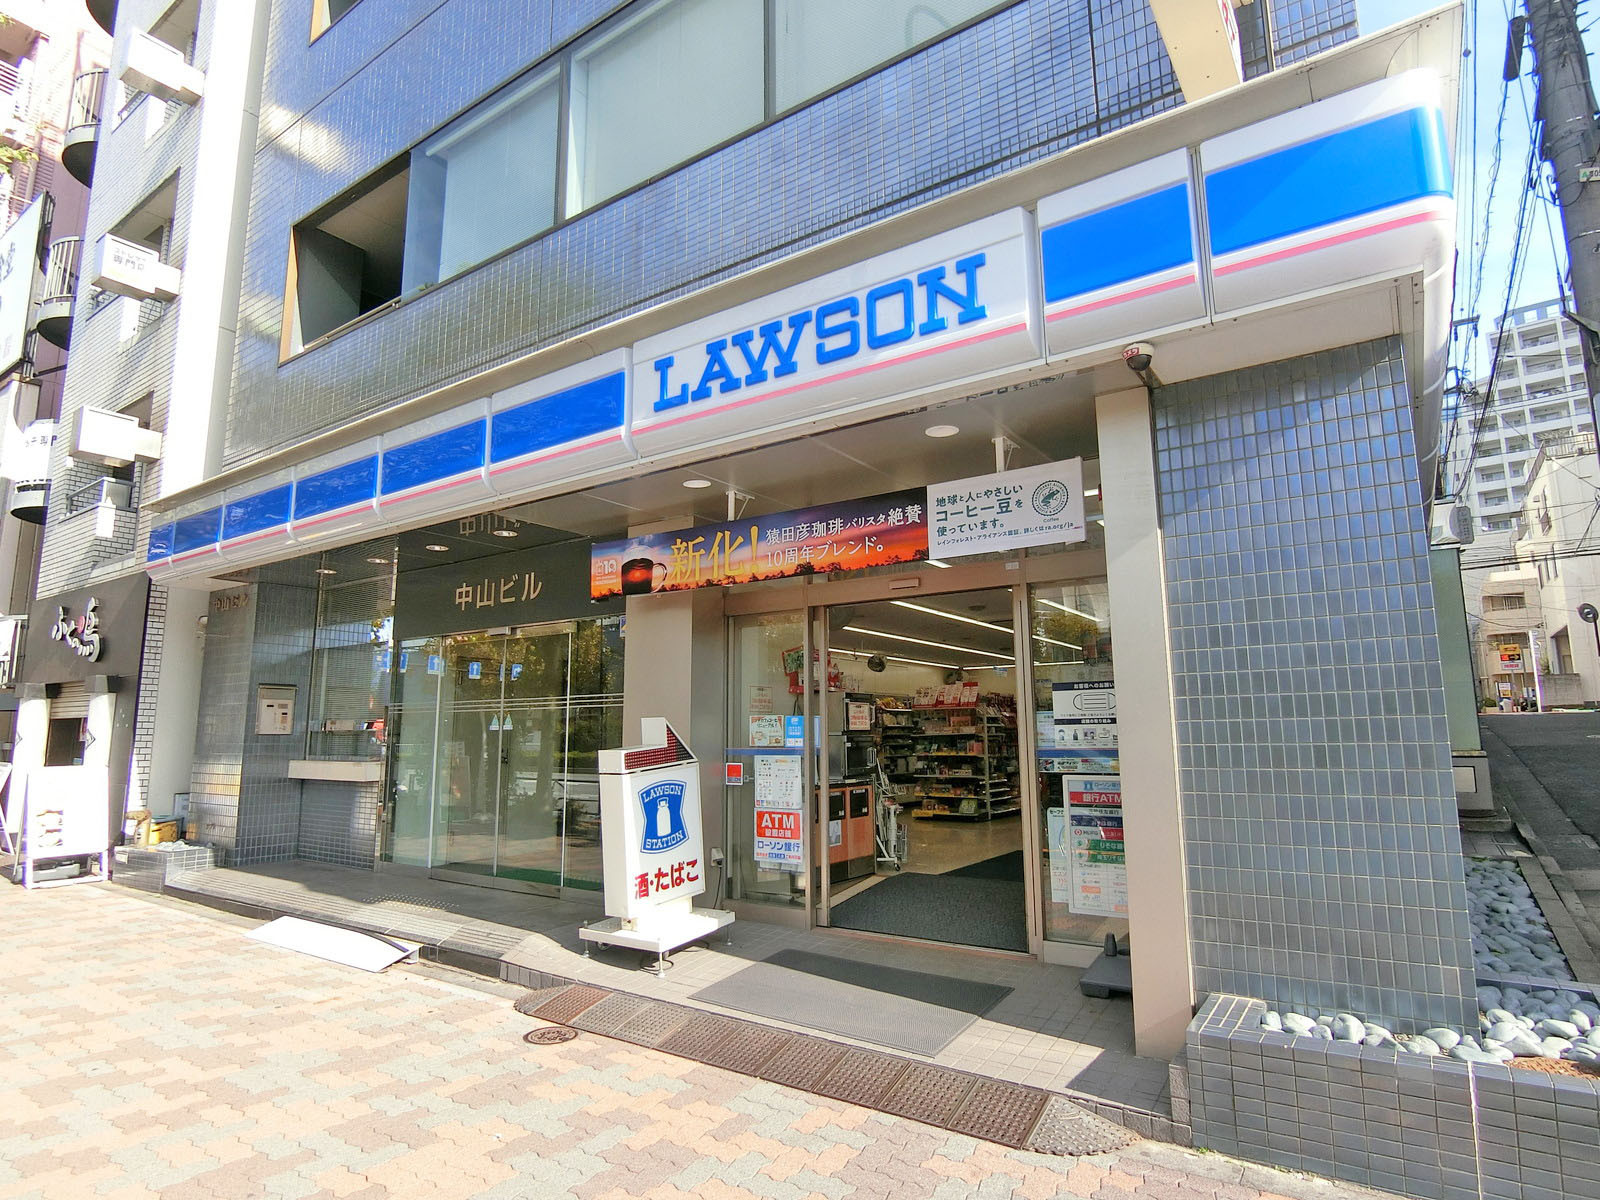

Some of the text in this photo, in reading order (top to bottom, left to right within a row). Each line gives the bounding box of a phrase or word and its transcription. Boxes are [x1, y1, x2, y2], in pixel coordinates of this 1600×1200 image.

[653, 252, 989, 412] LAWSON
[935, 484, 1043, 507] 地球と人にやさしい
[935, 497, 1023, 523] コーヒー豆を
[765, 503, 923, 546] 猿田彦珈琲バリスタ絶賛
[936, 518, 1005, 538] 使っています。
[767, 536, 884, 568] 10周年ブレンド。
[455, 572, 542, 611] 中山ビル
[643, 785, 682, 803] LAWSON
[761, 813, 794, 829] ATM
[645, 830, 684, 849] STATION
[757, 840, 801, 852] ローソン銀行
[635, 859, 699, 900] 酒・たばこ
